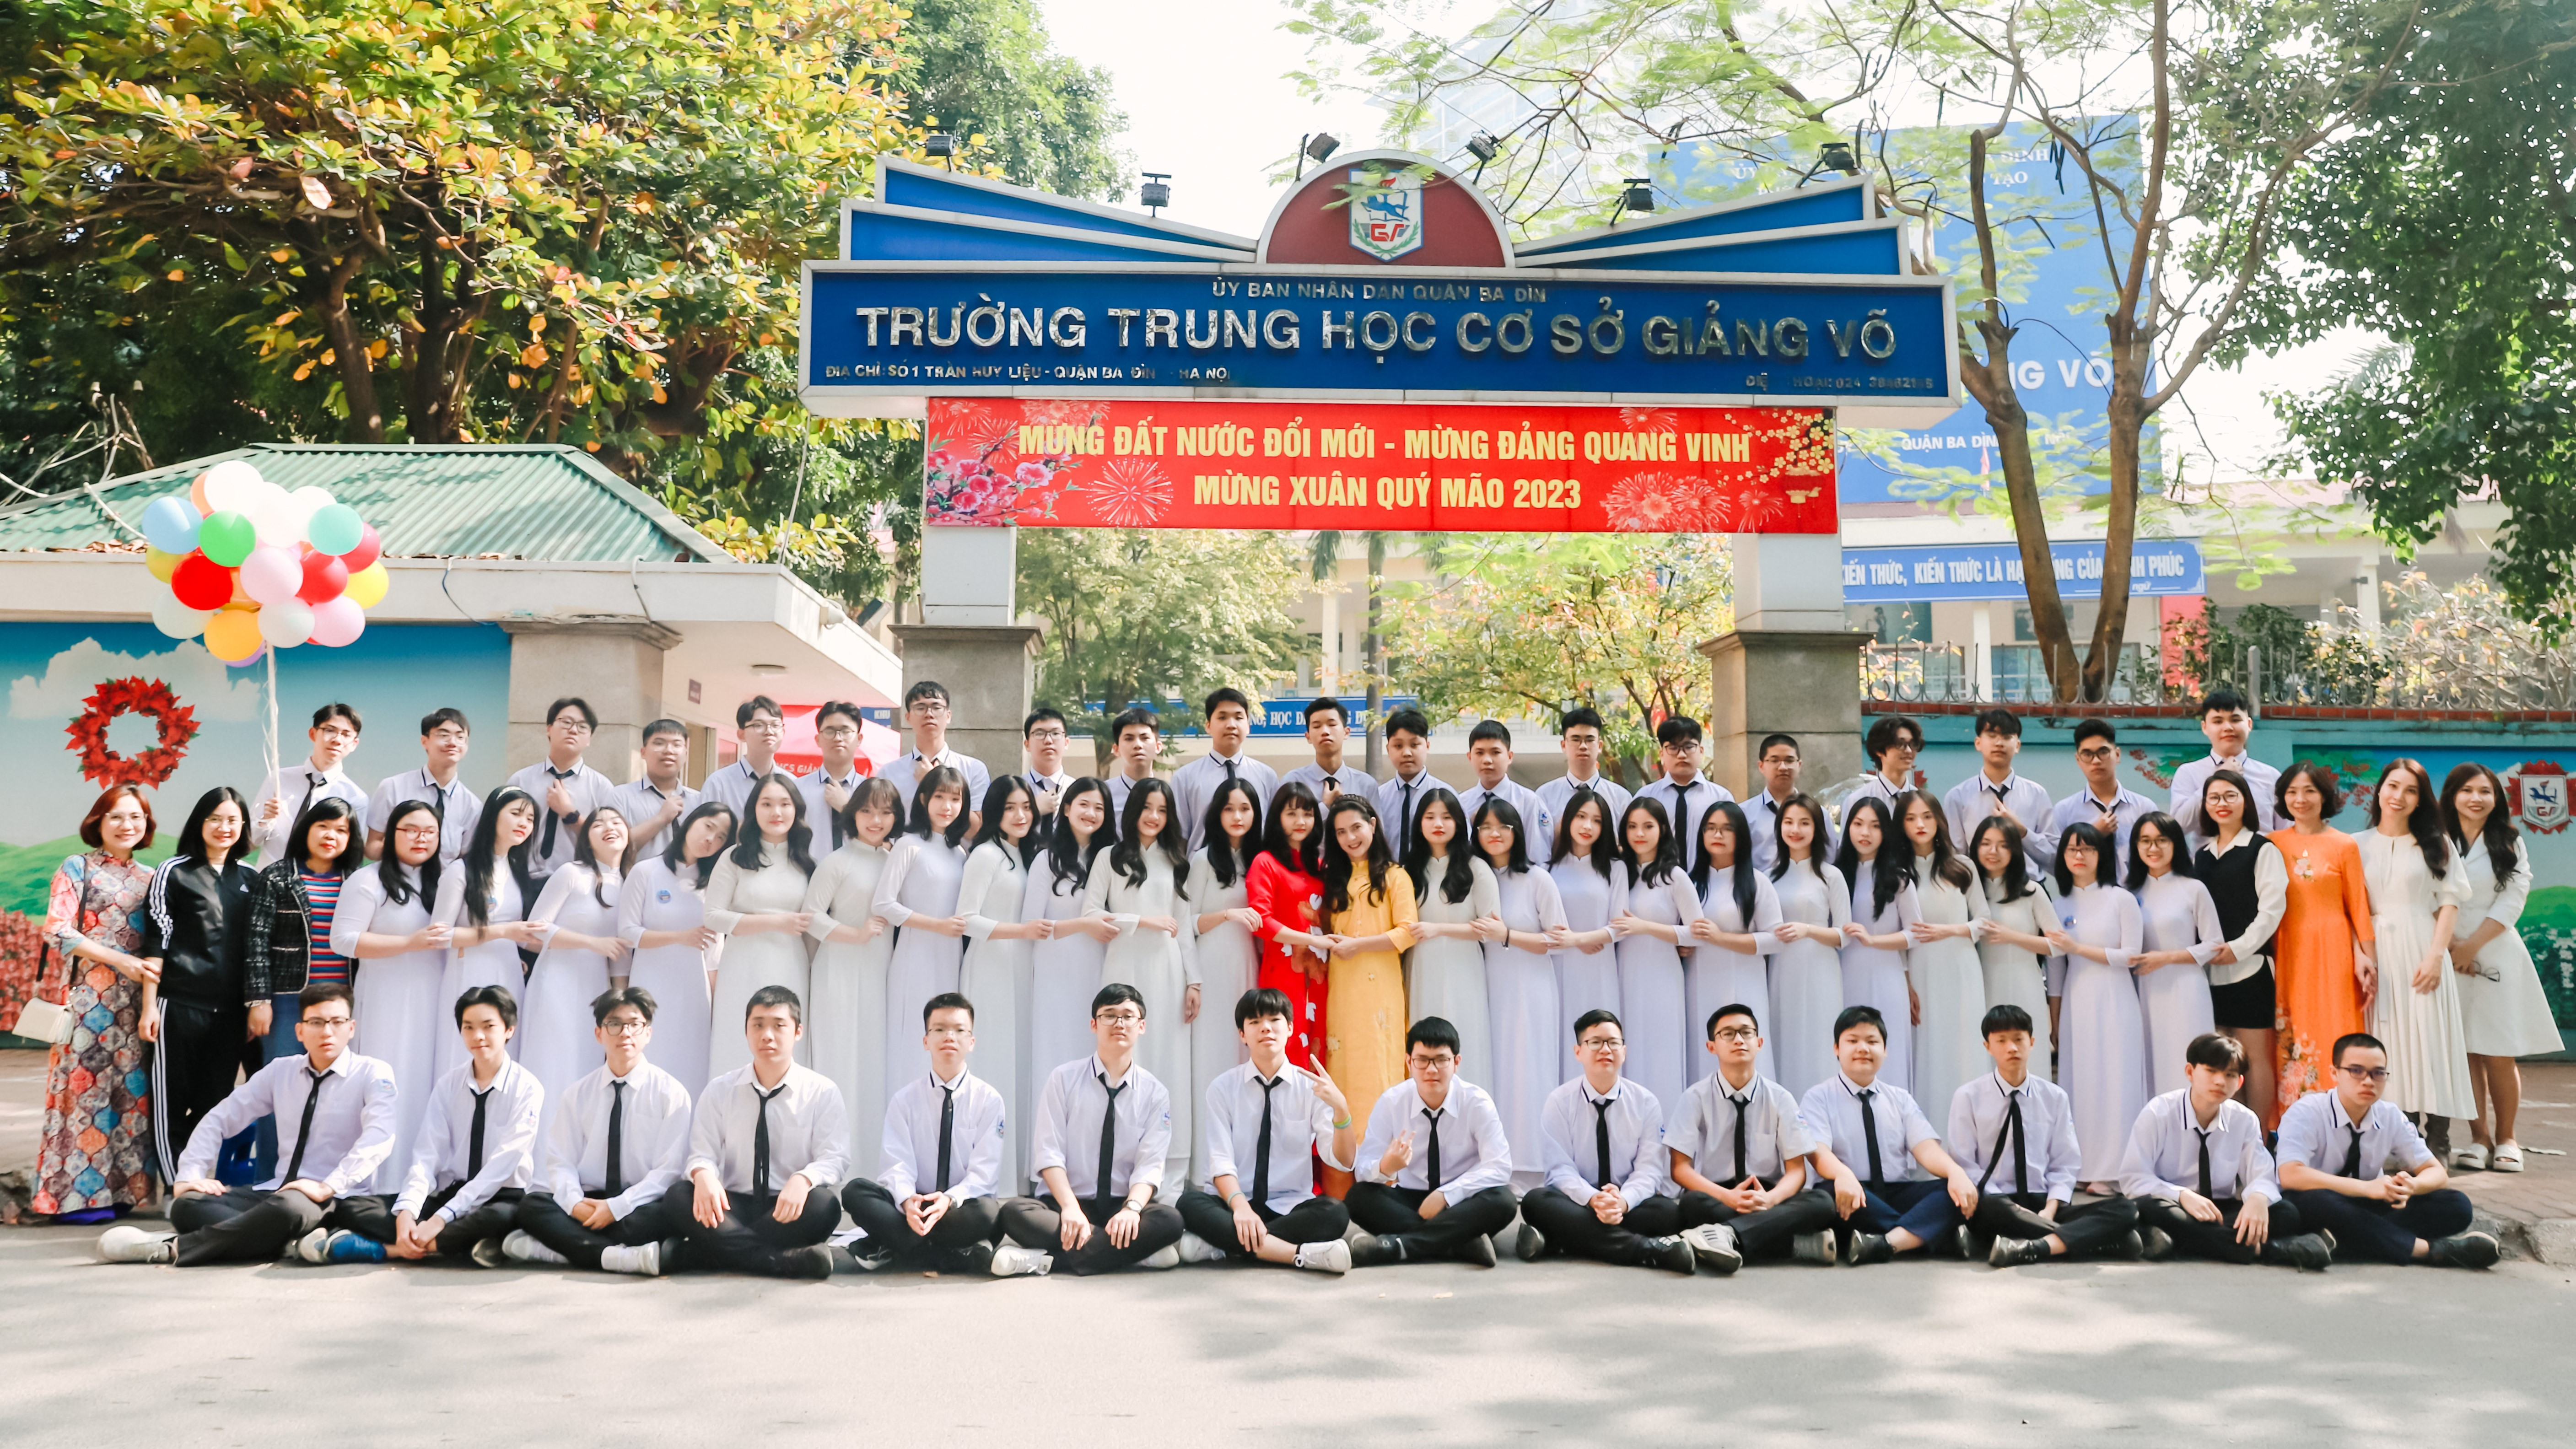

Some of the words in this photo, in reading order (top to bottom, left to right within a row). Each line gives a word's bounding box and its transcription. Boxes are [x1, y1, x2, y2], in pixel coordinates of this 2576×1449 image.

[1213, 276, 1240, 297] ỦY
[1248, 282, 1290, 298] BAN
[1298, 280, 1354, 299] NHÂN
[1479, 286, 1505, 302] BA
[856, 293, 1086, 348] TRƯỜNG
[1107, 307, 1300, 349] TRUNG
[1322, 310, 1436, 364] HỌC
[1456, 308, 1534, 353] CƠ
[1550, 296, 1626, 354] SỞ
[1642, 300, 1809, 356] GIẢNG
[1826, 308, 1897, 359] VÕ
[972, 366, 1003, 377] HUY
[1008, 363, 1041, 381] LIỆU
[1054, 364, 1098, 381] QUẬN
[1102, 367, 1123, 378] BA
[1836, 377, 1860, 389] 024
[1019, 419, 1105, 455] MỪNG
[1113, 415, 1168, 456] ĐẤT
[1176, 421, 1255, 457] NƯỚC
[1263, 416, 1311, 458] ĐỔI
[1320, 423, 1375, 458] MỚI
[1404, 424, 1489, 460] MỪNG
[1497, 421, 1575, 460] ĐẢNG
[1584, 431, 1677, 464] QUANG
[1684, 433, 1750, 463] VINH
[1902, 434, 1943, 453] QUẬN
[1946, 436, 1967, 449] BA
[1971, 431, 1999, 448] ĐÌN
[1194, 469, 1280, 506] MỪNG
[1289, 470, 1367, 506] XUÂN
[1376, 471, 1431, 510] QUÝ
[1440, 472, 1504, 508] MÃO
[1513, 479, 1581, 509] 2023
[1869, 559, 1908, 587] THỨC,
[1914, 556, 1945, 584] KIẾN
[1948, 556, 1983, 583] THỨC
[1985, 555, 2003, 582] LÀ
[2005, 560, 2025, 585] HẠ
[2076, 550, 2104, 580] CỦA
[2148, 550, 2185, 578] PHÚC
[874, 710, 890, 719] KHU
[1270, 711, 1292, 728] HỌC
